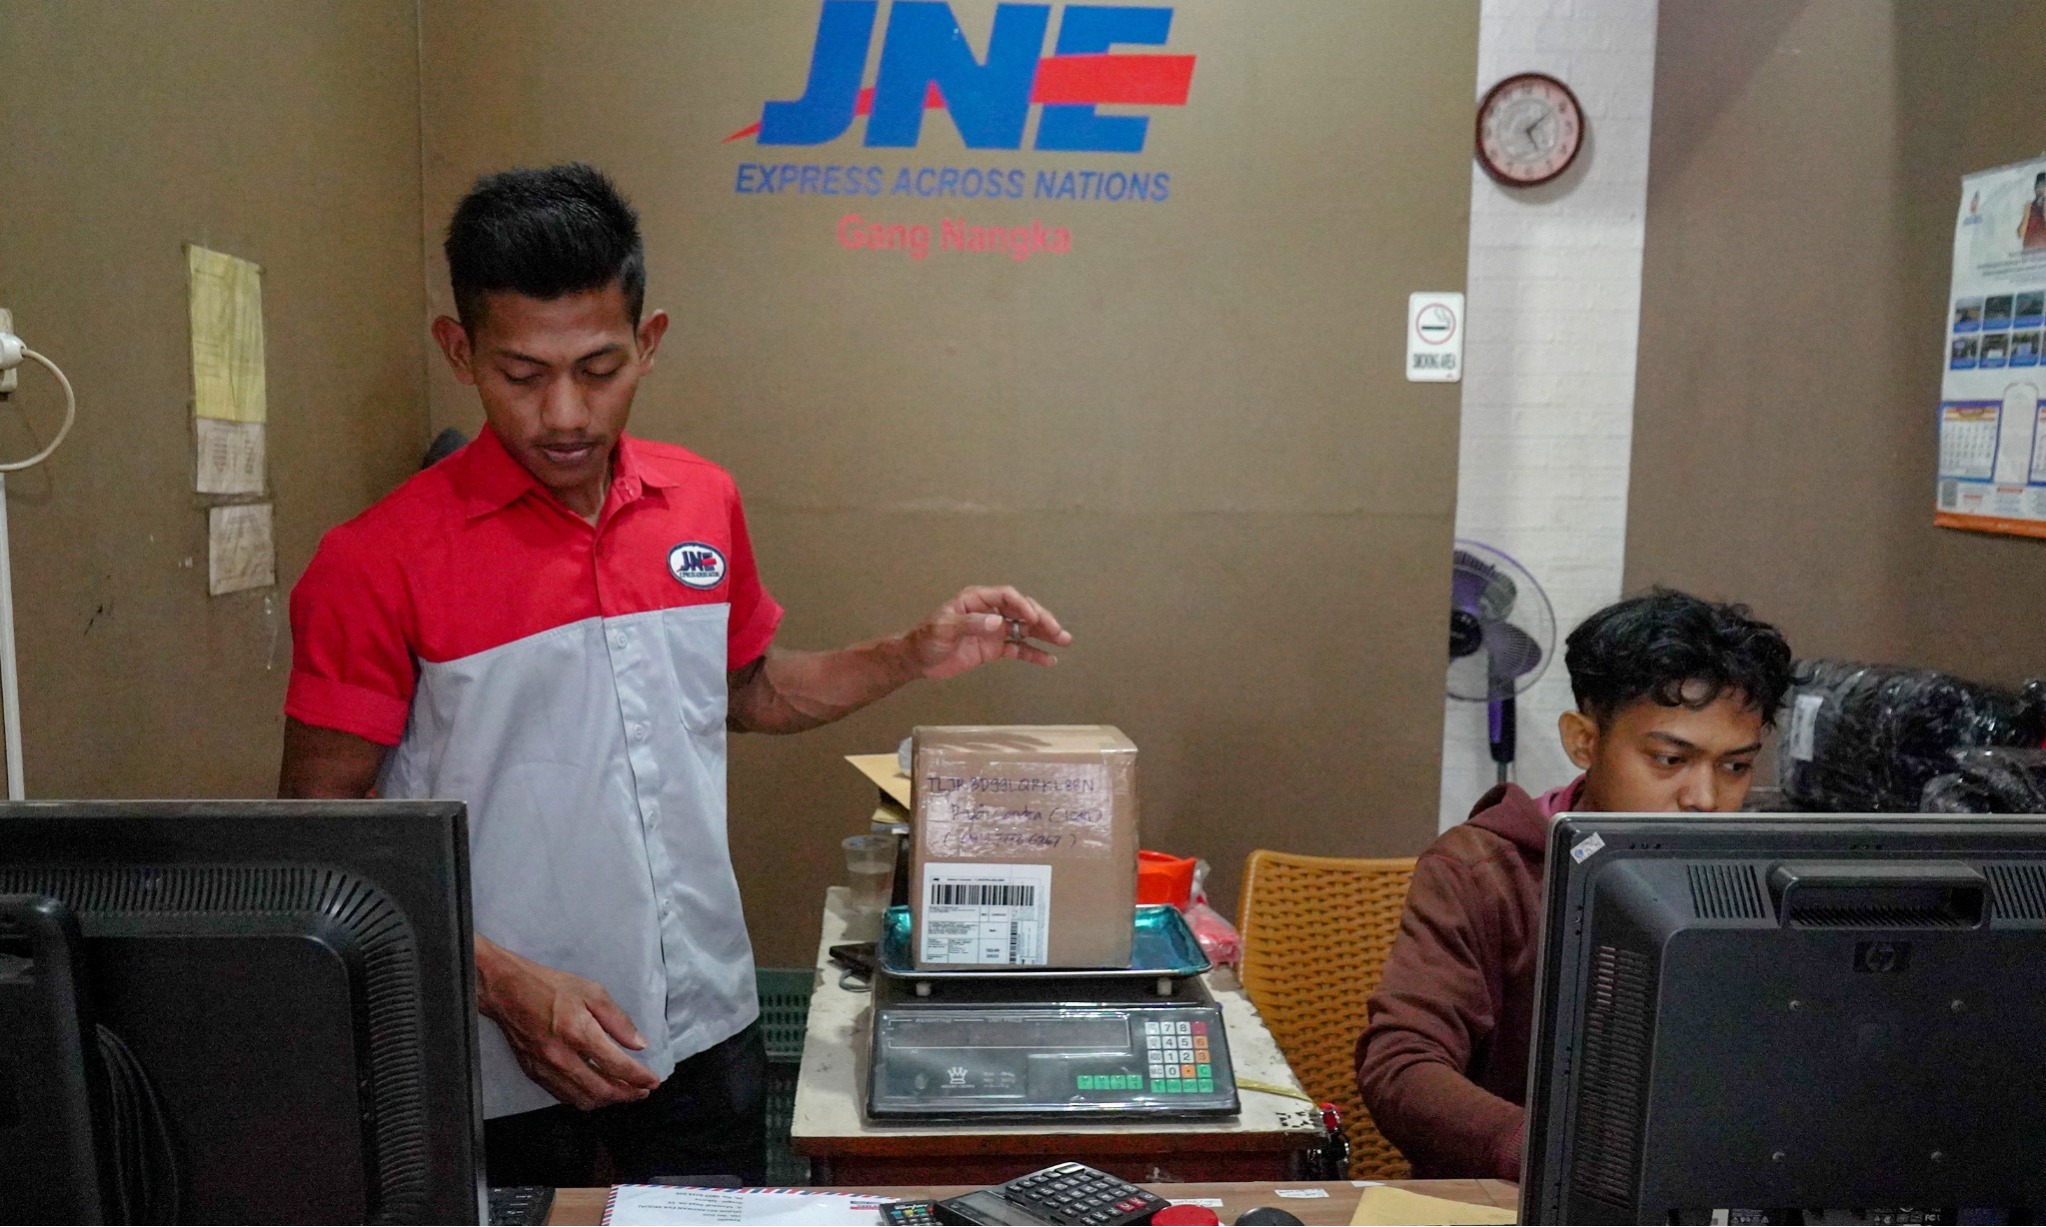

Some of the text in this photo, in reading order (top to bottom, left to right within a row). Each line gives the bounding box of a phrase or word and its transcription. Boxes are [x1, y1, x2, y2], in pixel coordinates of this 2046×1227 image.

[757, 0, 1195, 152] JNE
[736, 163, 1170, 202] EXPRESS ACROSS NATIONS
[836, 214, 1072, 262] Gang Nangka
[681, 551, 716, 571] JNE
[1164, 1024, 1187, 1032] 7 8
[1169, 1067, 1176, 1075] 0
